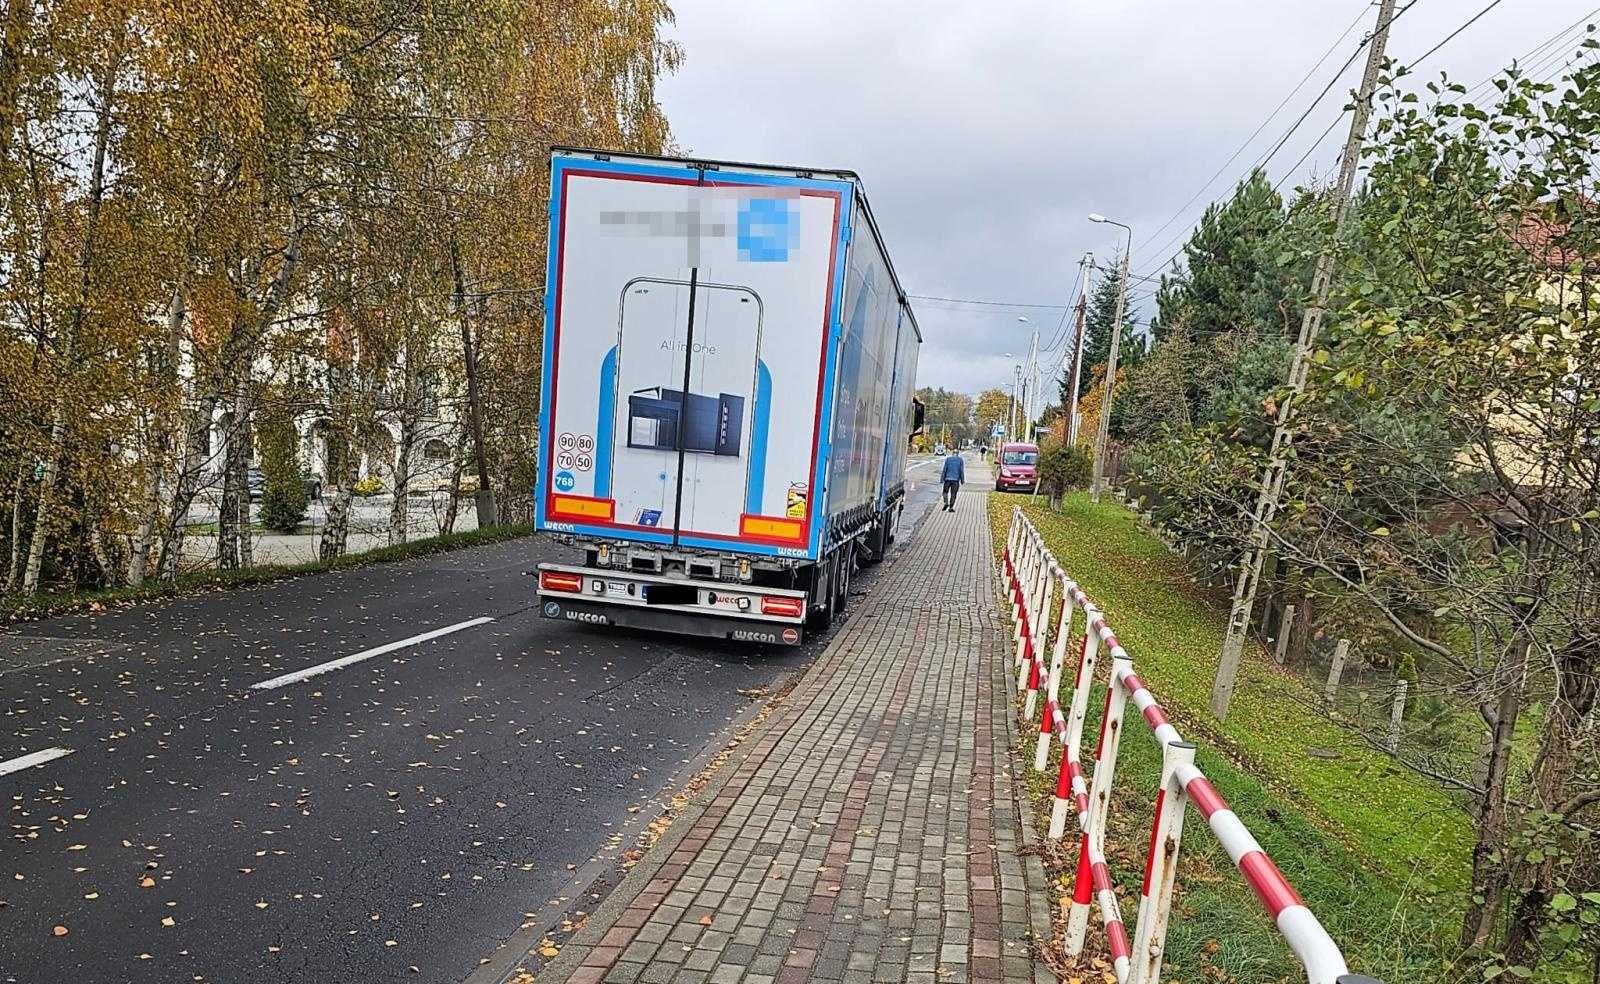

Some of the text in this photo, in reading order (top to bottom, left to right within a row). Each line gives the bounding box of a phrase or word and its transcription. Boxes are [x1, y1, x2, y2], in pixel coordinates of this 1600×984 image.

[660, 340, 675, 351] All
[692, 343, 716, 355] One
[561, 436, 592, 448] 90 80
[559, 455, 590, 469] 70 50
[556, 476, 574, 487] 768
[544, 521, 574, 532] wecon
[777, 547, 809, 558] wecon
[716, 596, 740, 604] weco
[566, 610, 607, 624] wecon
[734, 630, 776, 643] wecon
